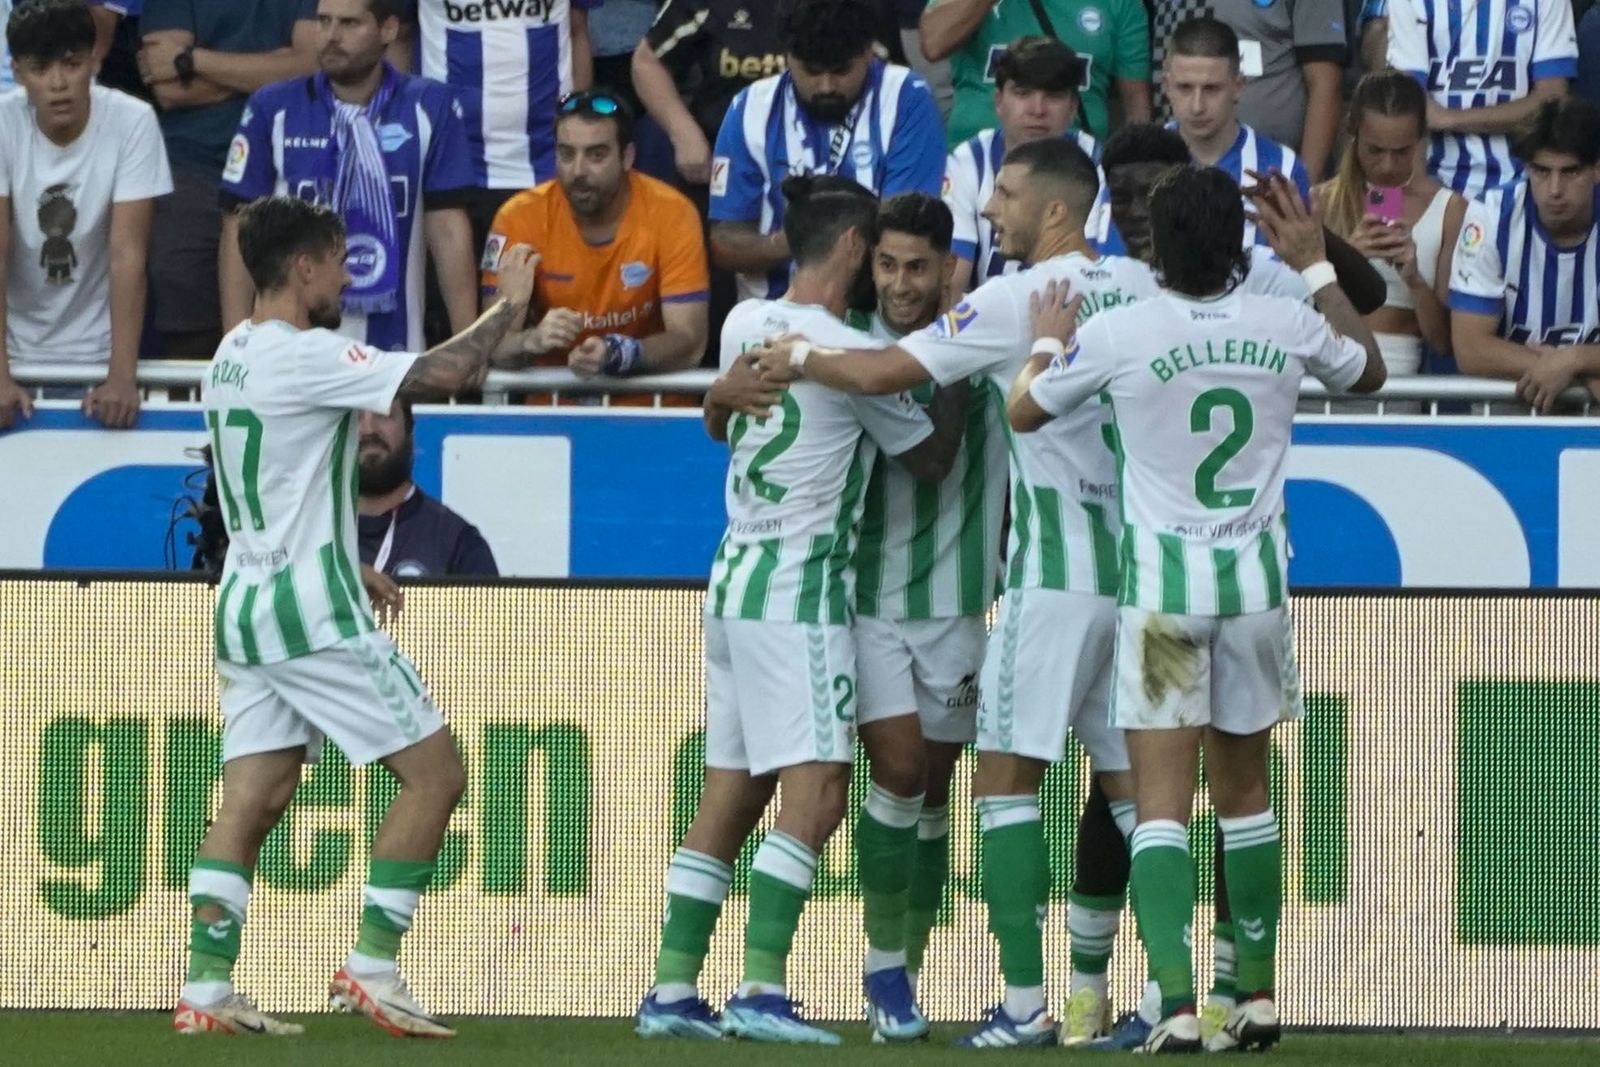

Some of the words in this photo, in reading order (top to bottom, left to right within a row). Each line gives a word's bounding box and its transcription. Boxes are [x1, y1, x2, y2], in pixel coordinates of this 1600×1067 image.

[1427, 60, 1516, 91] LEA
[1150, 339, 1288, 383] BELLERÍN
[208, 409, 265, 531] 17
[1190, 388, 1257, 509] 2
